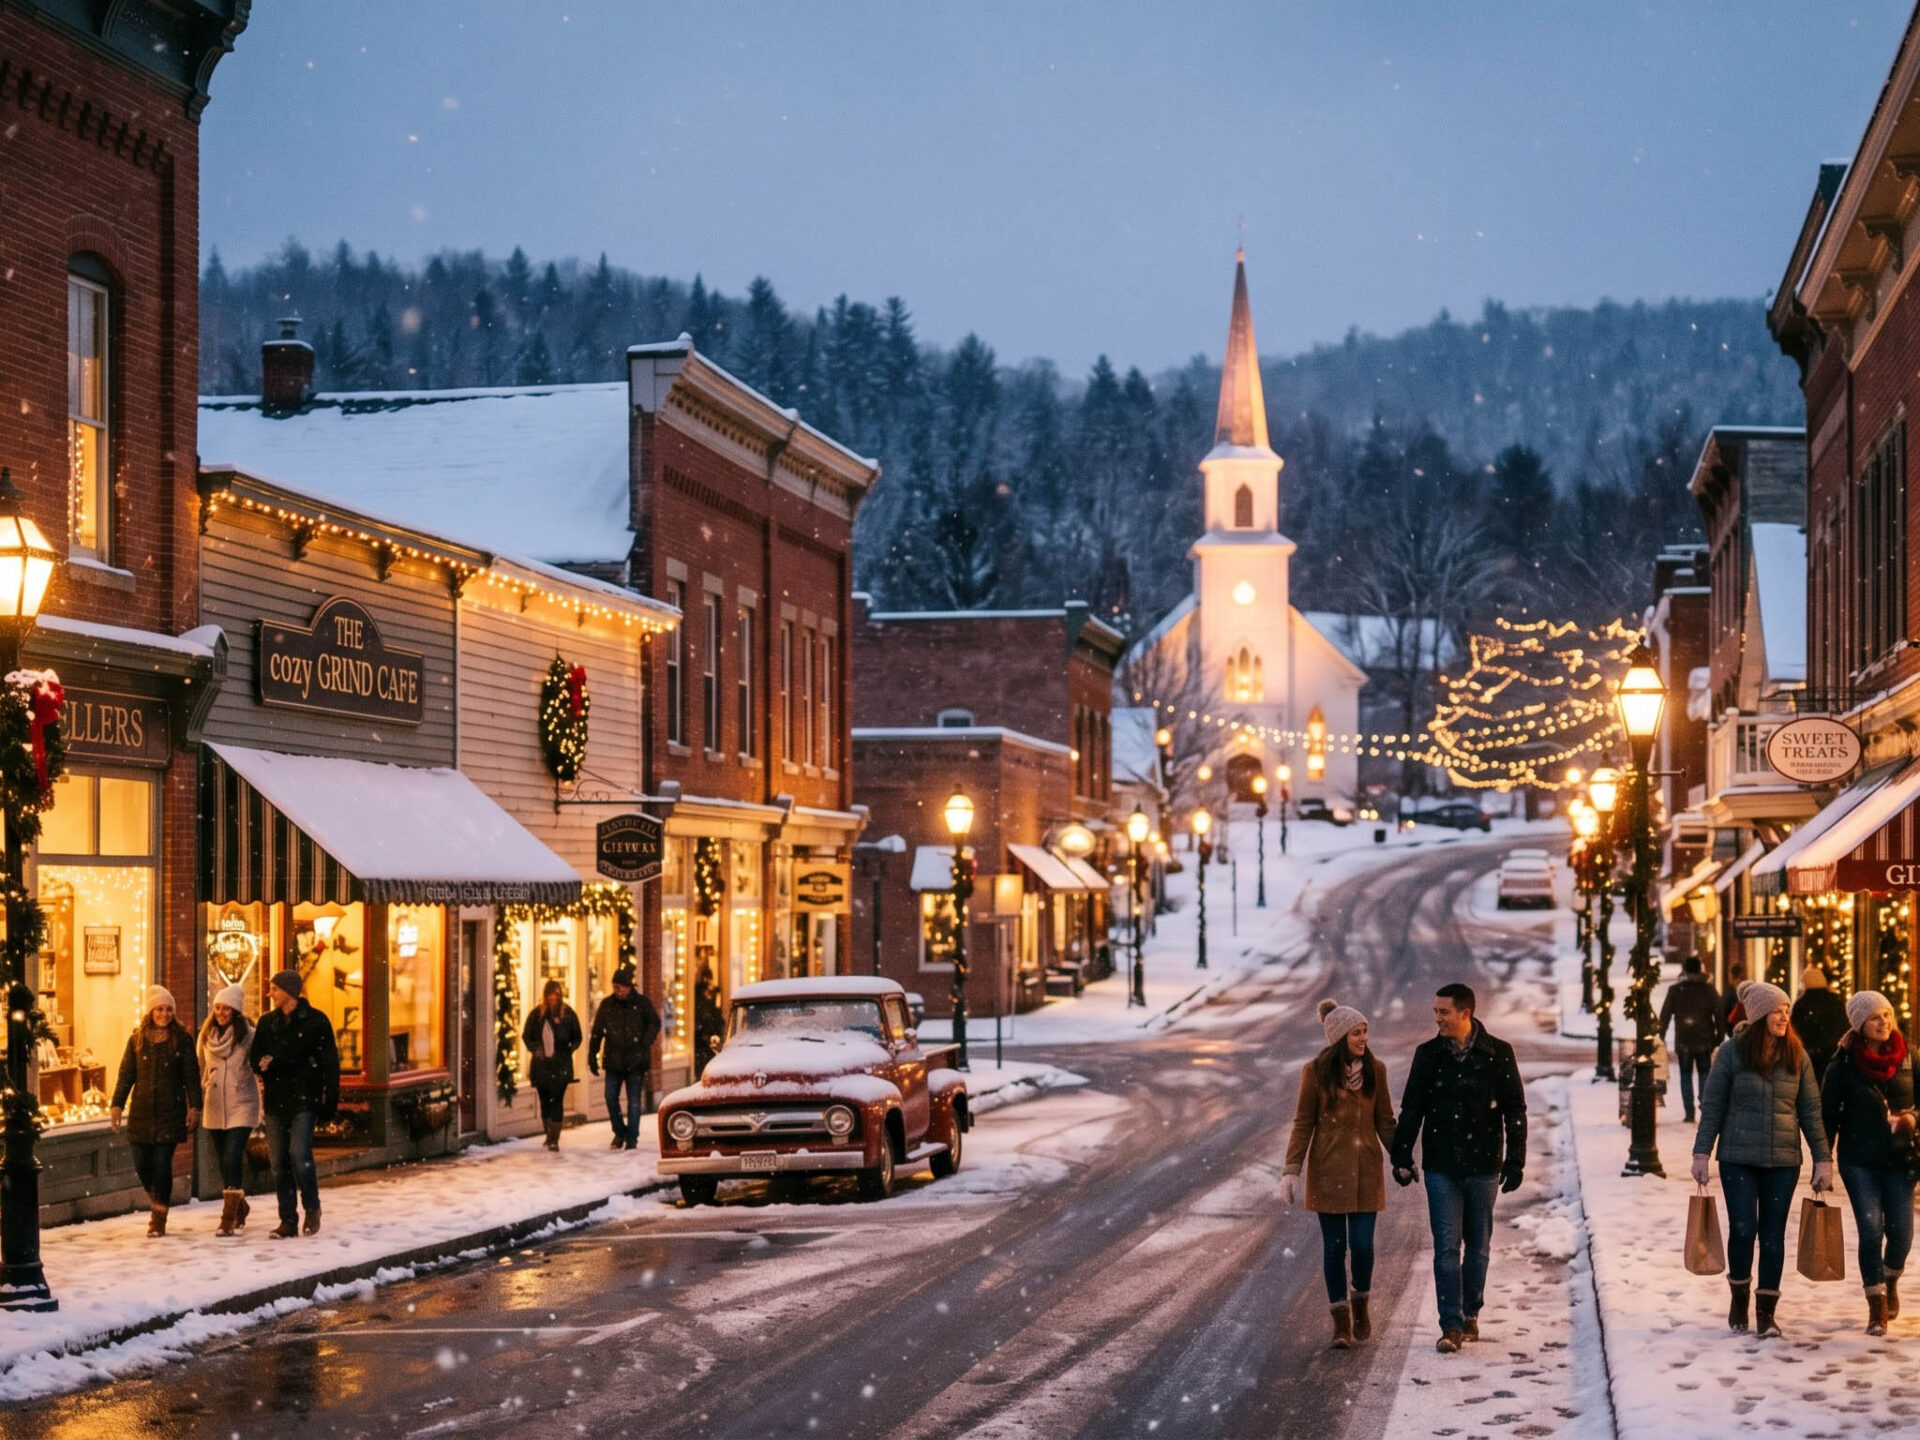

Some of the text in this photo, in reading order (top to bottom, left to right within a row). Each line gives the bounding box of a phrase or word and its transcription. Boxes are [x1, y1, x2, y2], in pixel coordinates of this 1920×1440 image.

[334, 616, 364, 650] THE
[270, 653, 418, 704] cozy GRIND CAFE
[1782, 733, 1847, 745] SWEET
[1781, 746, 1848, 759] TREATS
[1885, 864, 1920, 885] GI
